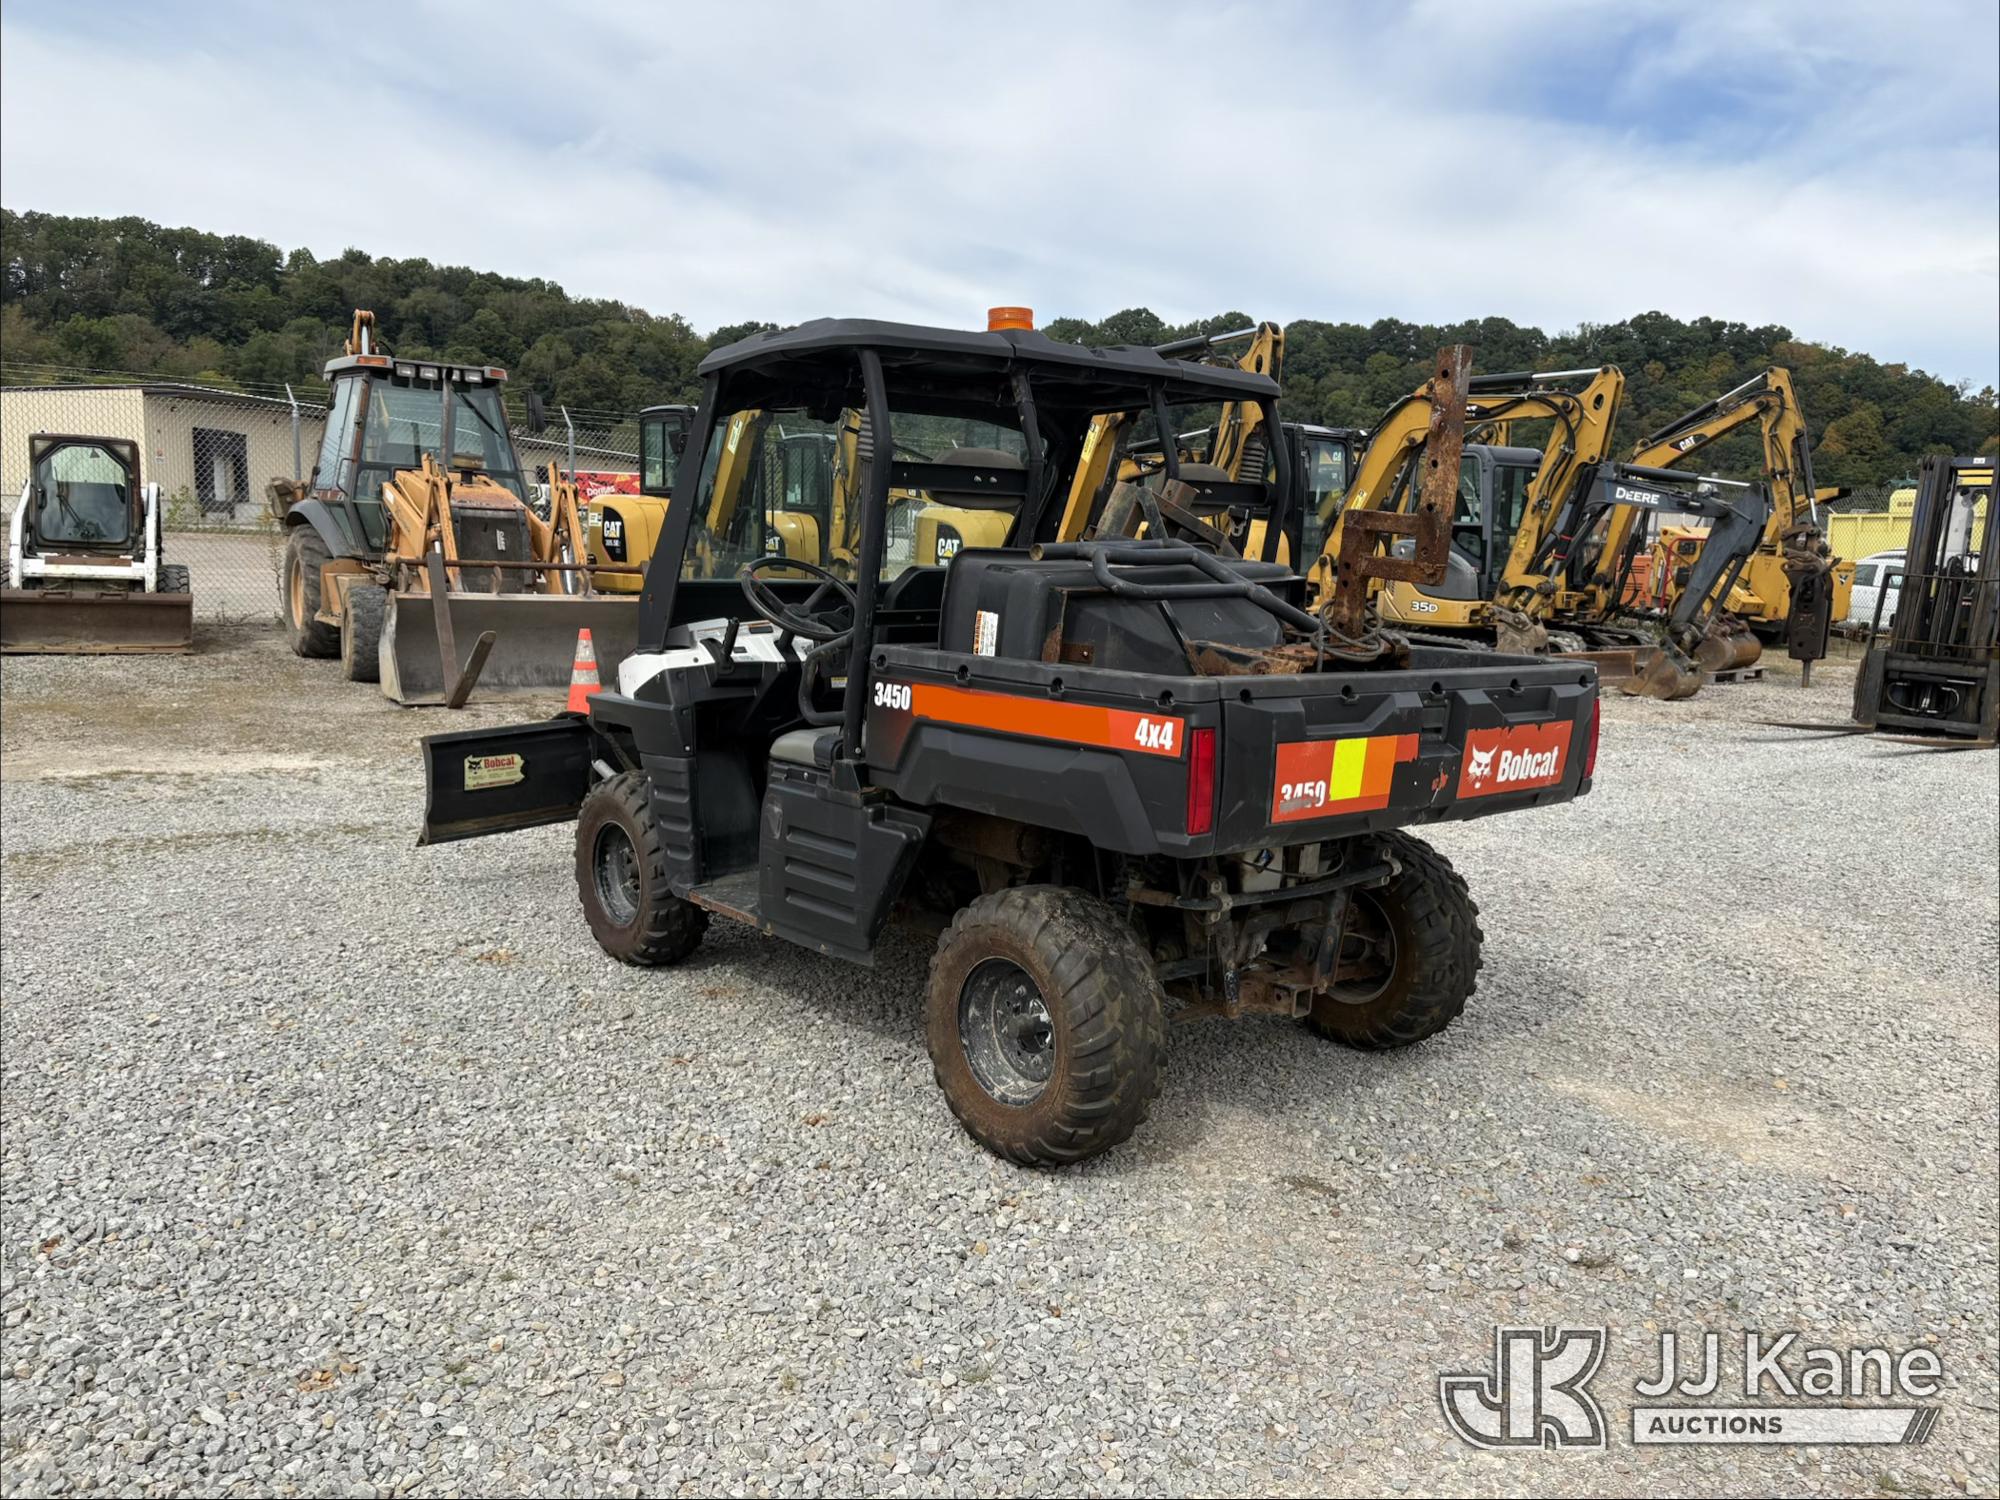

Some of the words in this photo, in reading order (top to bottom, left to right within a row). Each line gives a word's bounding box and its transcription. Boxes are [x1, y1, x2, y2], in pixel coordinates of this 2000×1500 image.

[1679, 436, 1696, 451] CAT
[1615, 486, 1660, 505] DEERE
[603, 520, 622, 538] CAT
[937, 538, 960, 557] CAT
[1411, 601, 1439, 613] 35D
[873, 681, 911, 711] 3450
[1134, 718, 1174, 750] 4x4
[483, 756, 516, 769] Bobcat
[1495, 746, 1560, 783] Bobcat
